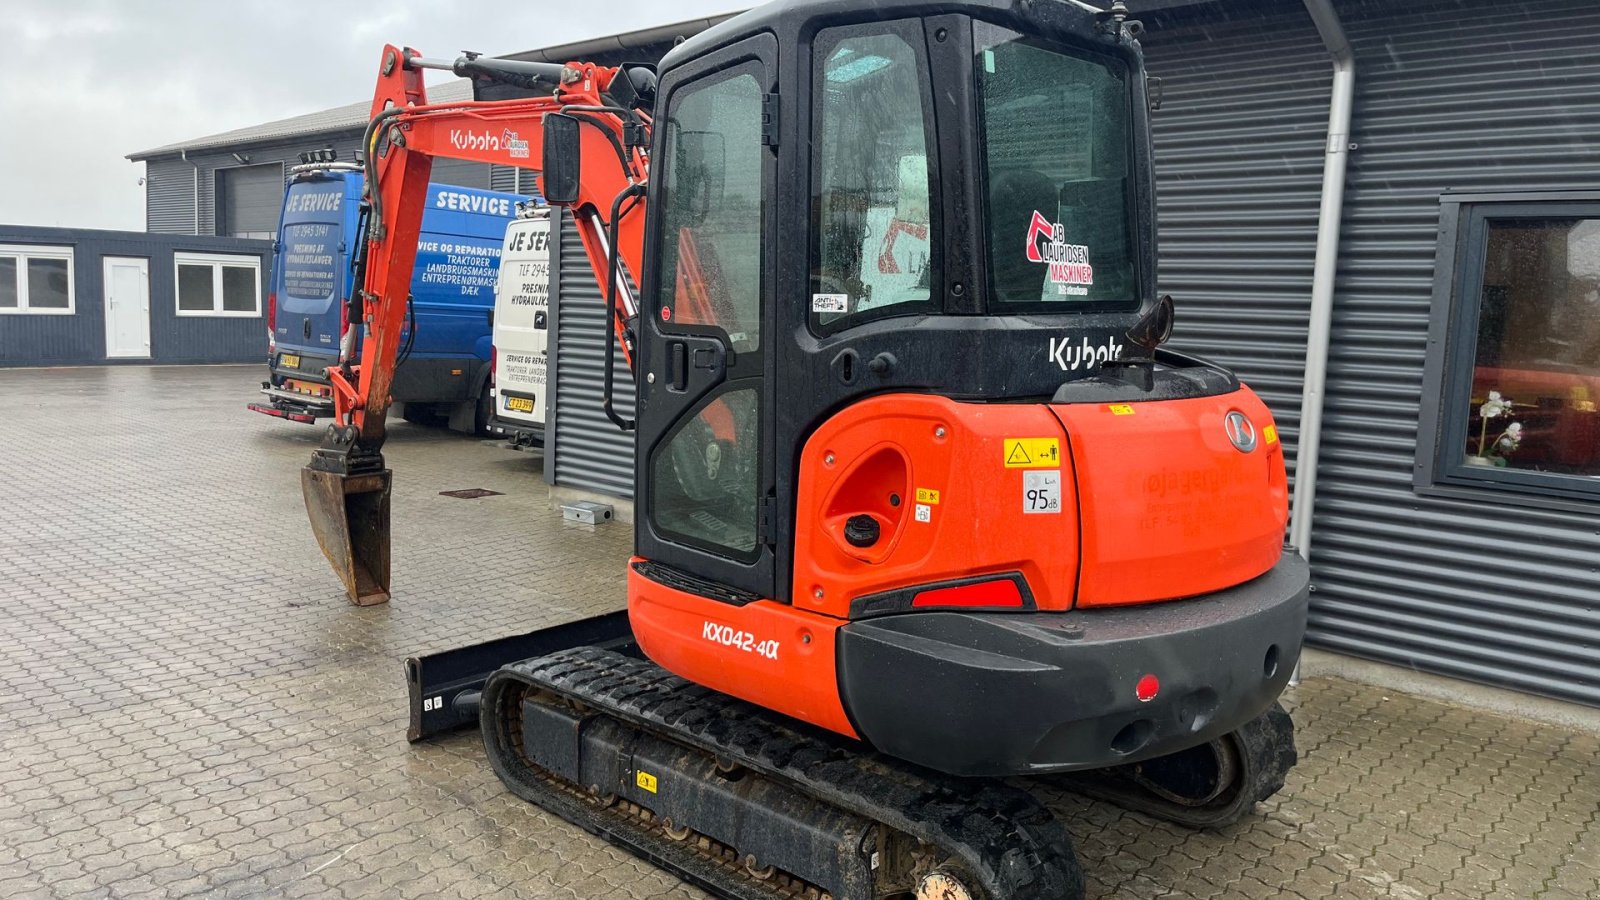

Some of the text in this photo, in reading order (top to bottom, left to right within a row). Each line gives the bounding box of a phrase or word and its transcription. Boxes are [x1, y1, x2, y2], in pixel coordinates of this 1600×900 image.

[450, 129, 499, 151] Kubota
[287, 192, 343, 212] JE SERVICE
[436, 191, 509, 216] SERVICE
[509, 232, 526, 251] JE
[1053, 224, 1064, 244] AB
[440, 243, 453, 253] OG
[1043, 243, 1088, 264] LAURIDSEN
[447, 255, 490, 267] TRAKTORER
[519, 264, 530, 276] TLF
[1050, 264, 1092, 283] MASKINER
[461, 285, 479, 296] DÆK
[506, 354, 524, 363] SERVICE
[525, 356, 531, 364] OG
